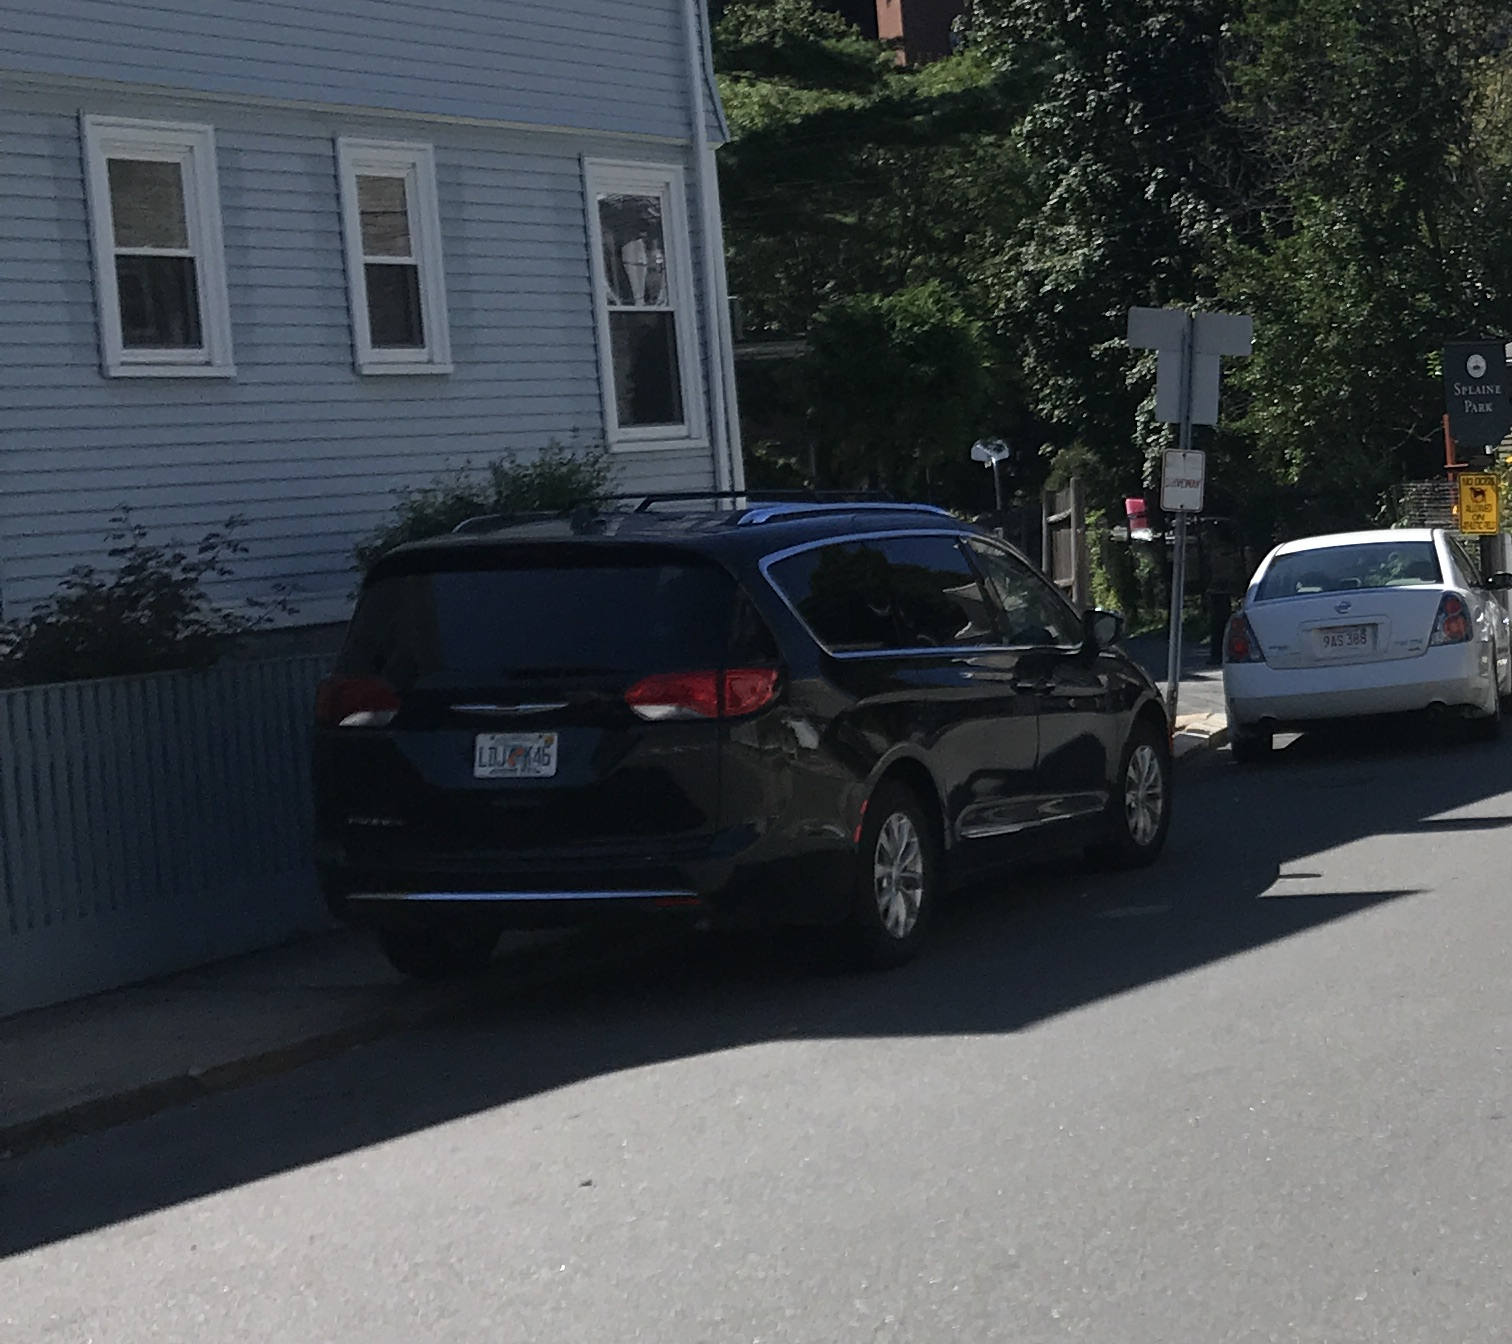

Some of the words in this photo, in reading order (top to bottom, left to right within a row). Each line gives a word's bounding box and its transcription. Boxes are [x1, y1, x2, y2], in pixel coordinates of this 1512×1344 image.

[1453, 382, 1502, 396] SPLAINE
[1464, 399, 1493, 413] PARK
[1461, 477, 1473, 486] NO
[1475, 477, 1495, 486] DOGS
